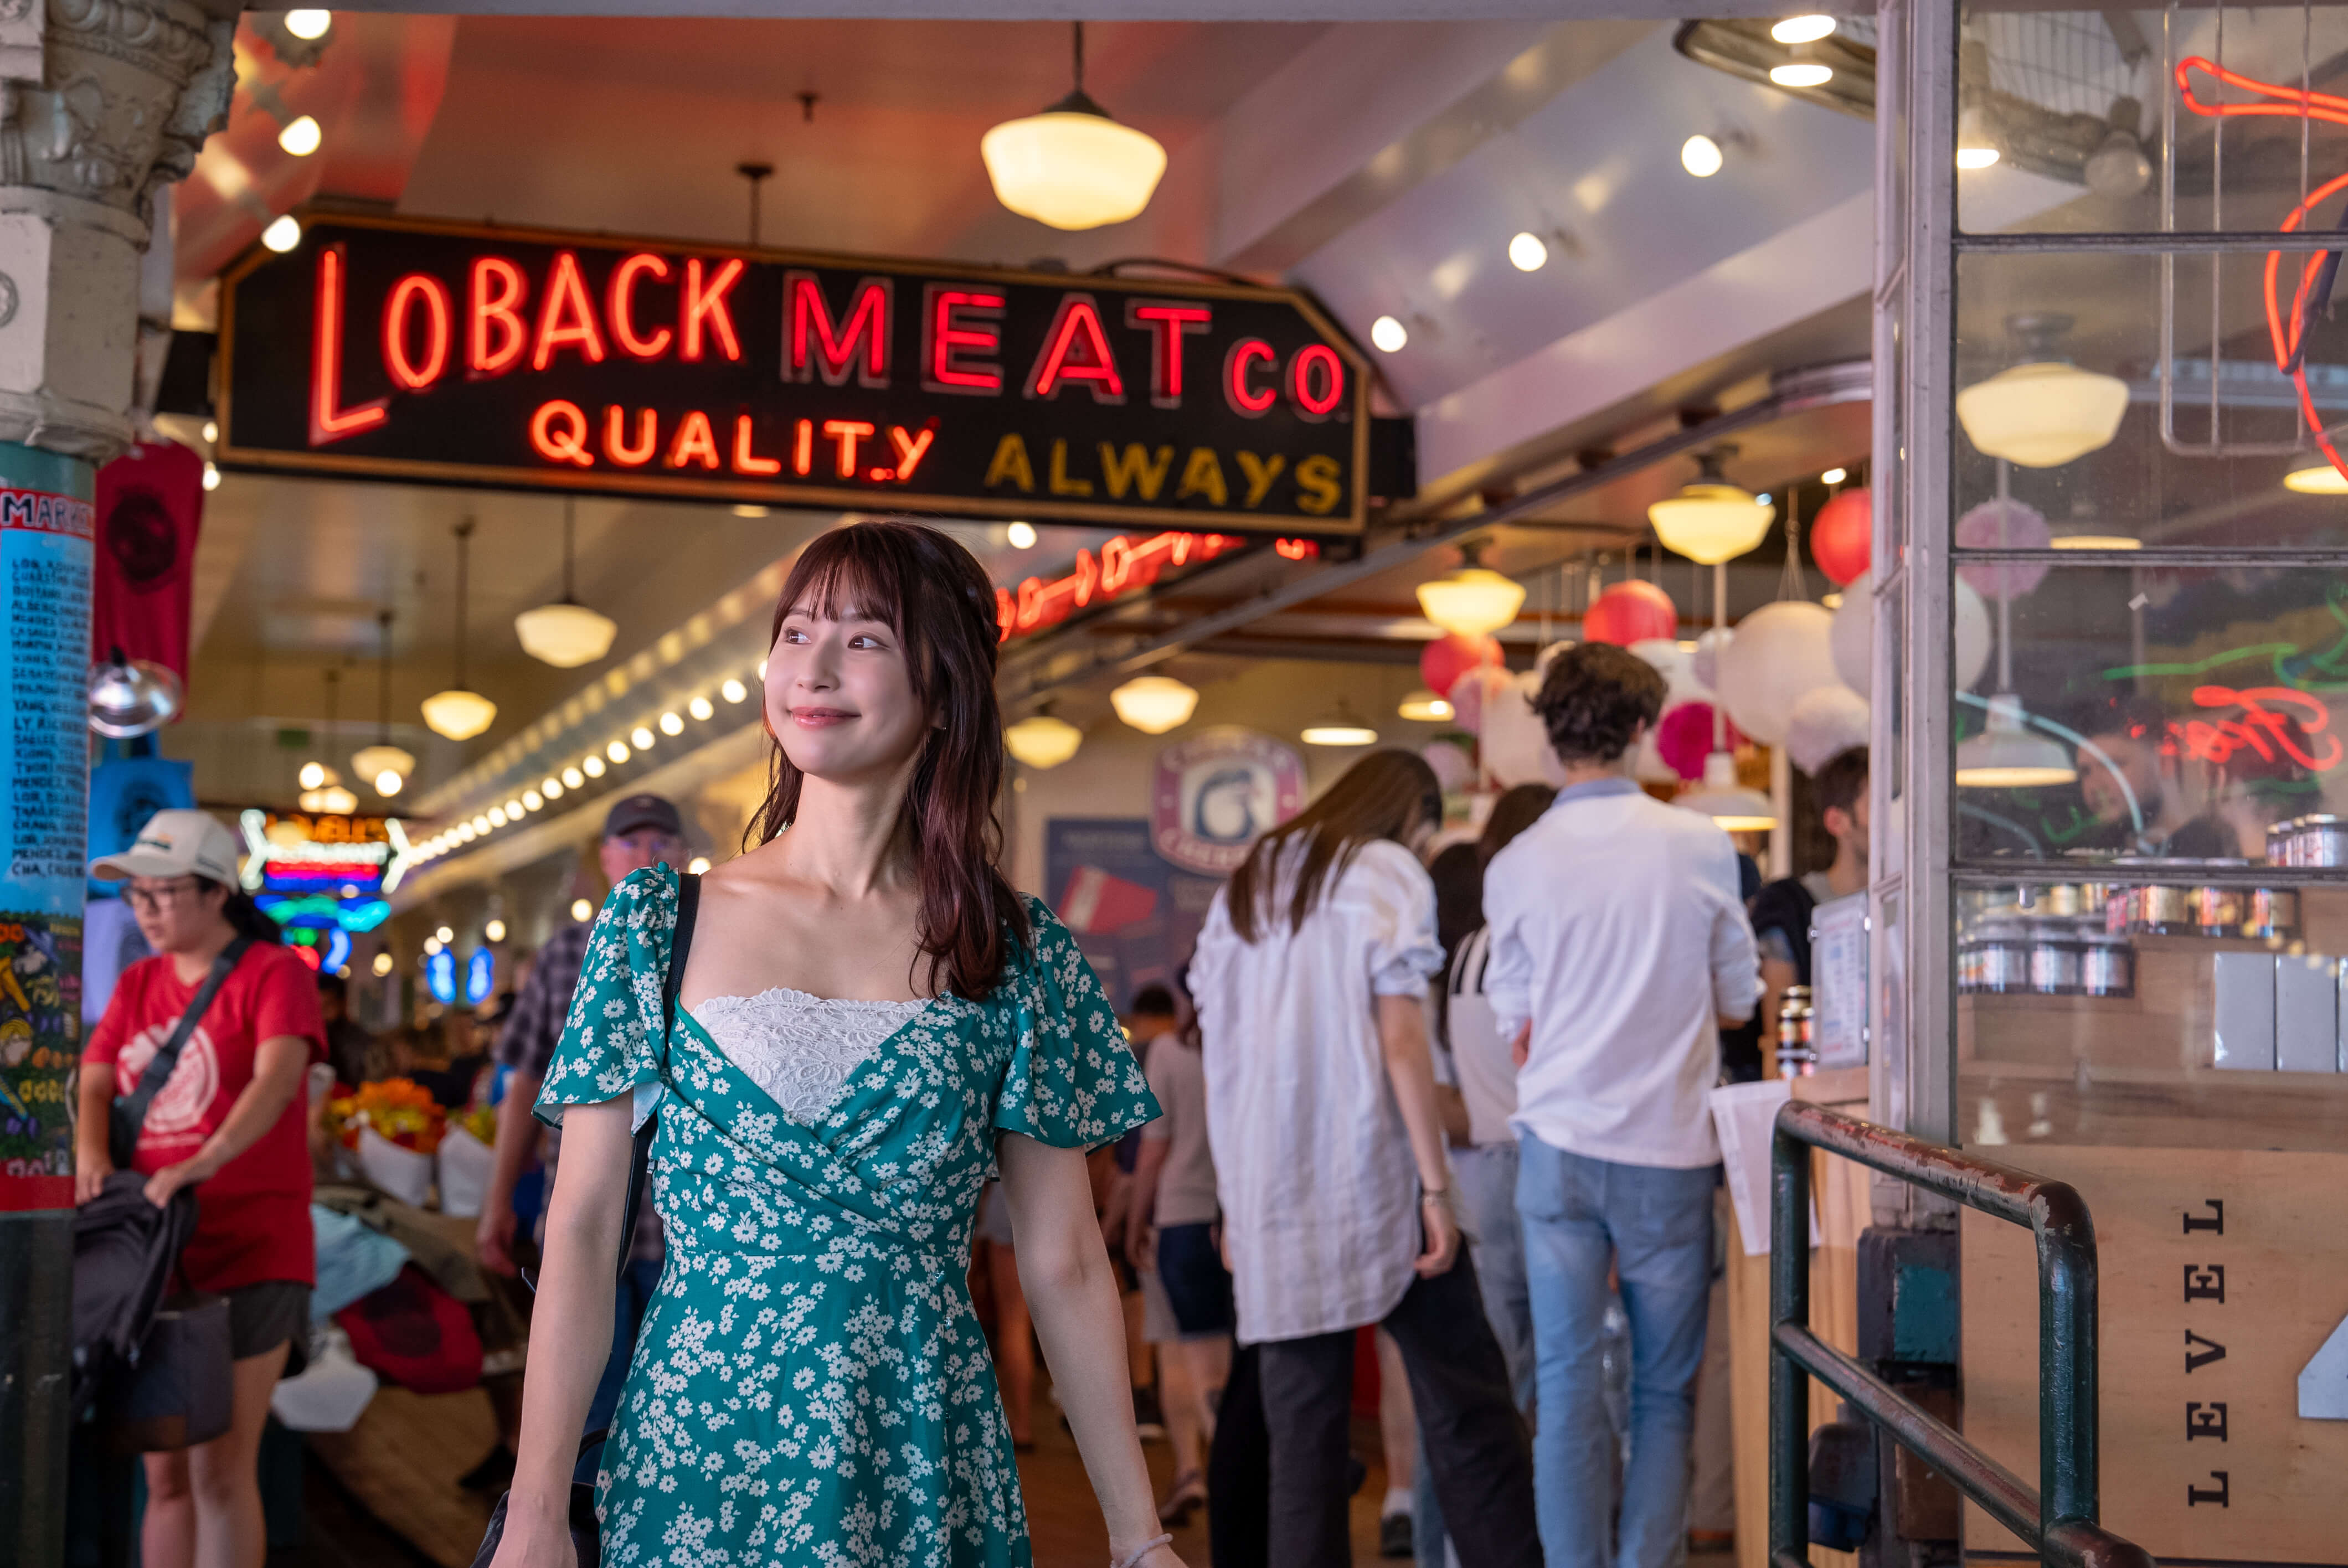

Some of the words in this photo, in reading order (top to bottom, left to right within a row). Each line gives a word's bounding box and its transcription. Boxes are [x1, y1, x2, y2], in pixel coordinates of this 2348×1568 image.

[309, 241, 745, 447] LOBACK
[781, 269, 1213, 409] MEAT
[1222, 337, 1348, 422] CO
[529, 399, 940, 482] QUALITY
[984, 432, 1342, 515] ALWAYS
[2182, 1198, 2229, 1508] LEVEL
